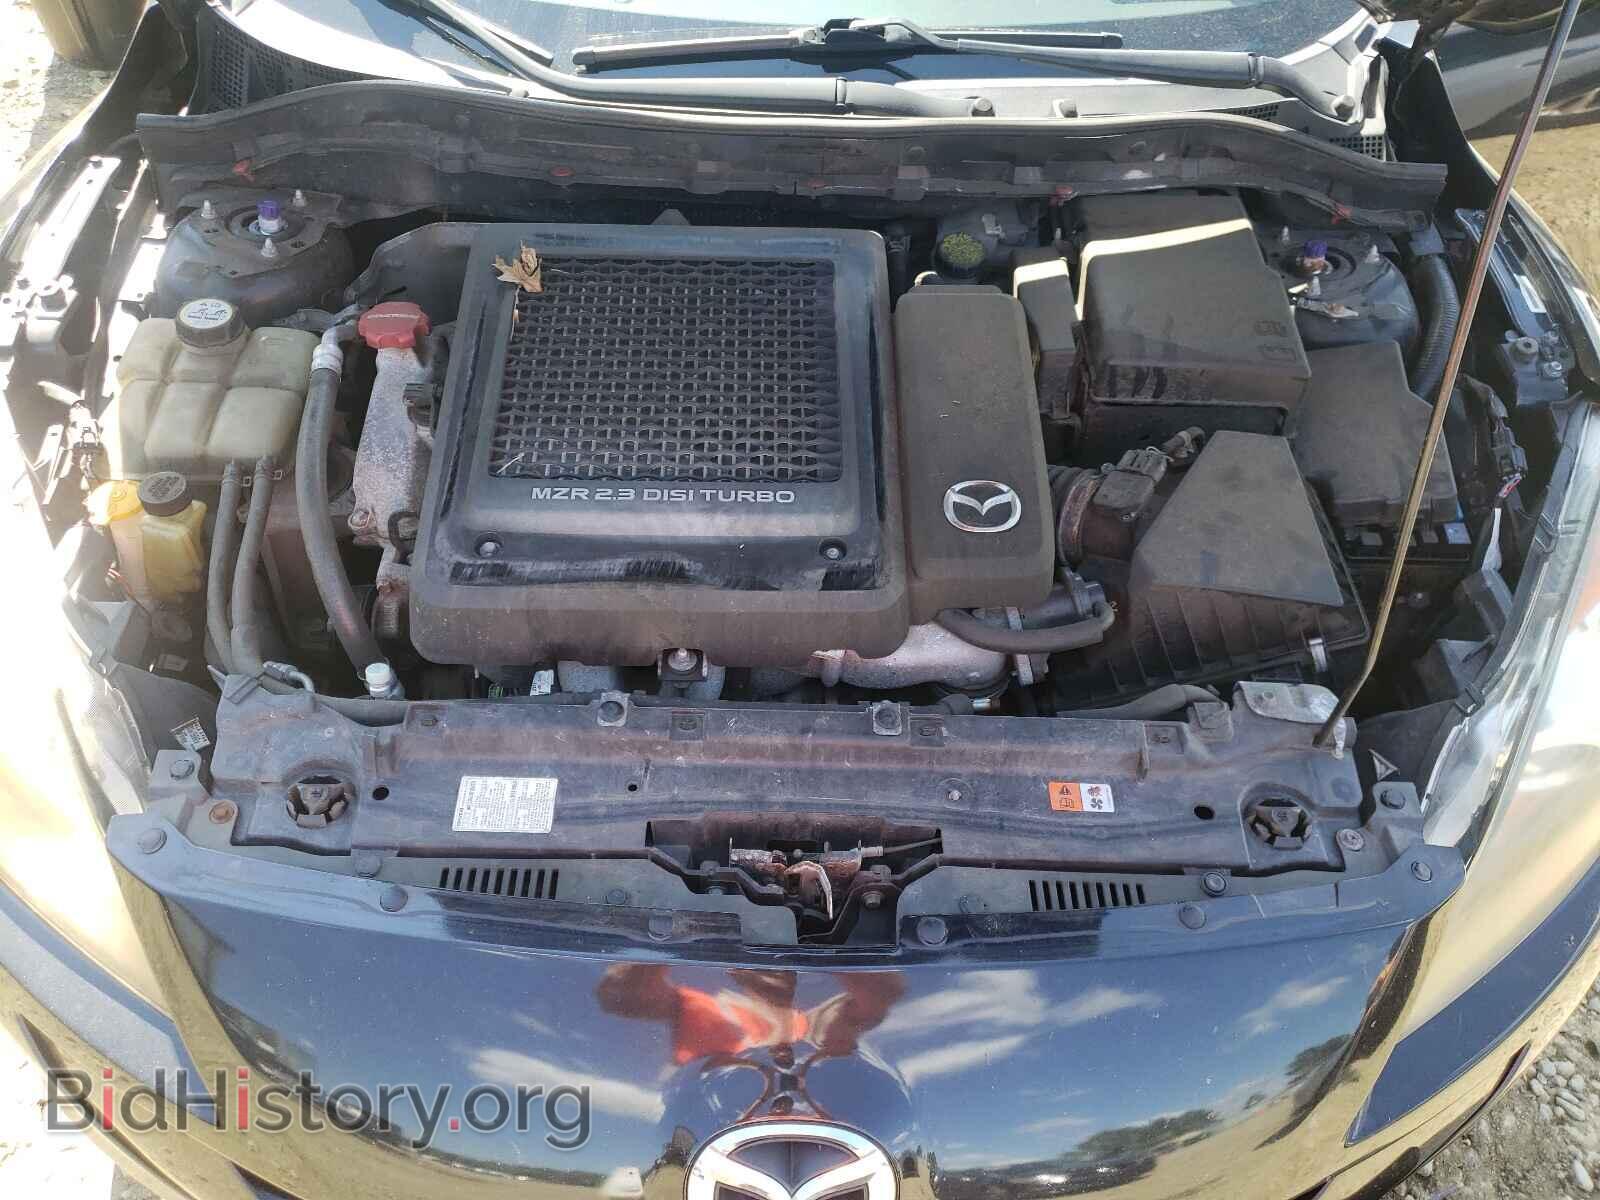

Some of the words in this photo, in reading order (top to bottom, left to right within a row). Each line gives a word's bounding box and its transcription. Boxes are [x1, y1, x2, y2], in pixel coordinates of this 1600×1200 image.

[531, 487, 589, 501] MZR
[594, 488, 636, 501] 2.3
[643, 488, 695, 502] DISI
[700, 489, 796, 503] TURBO
